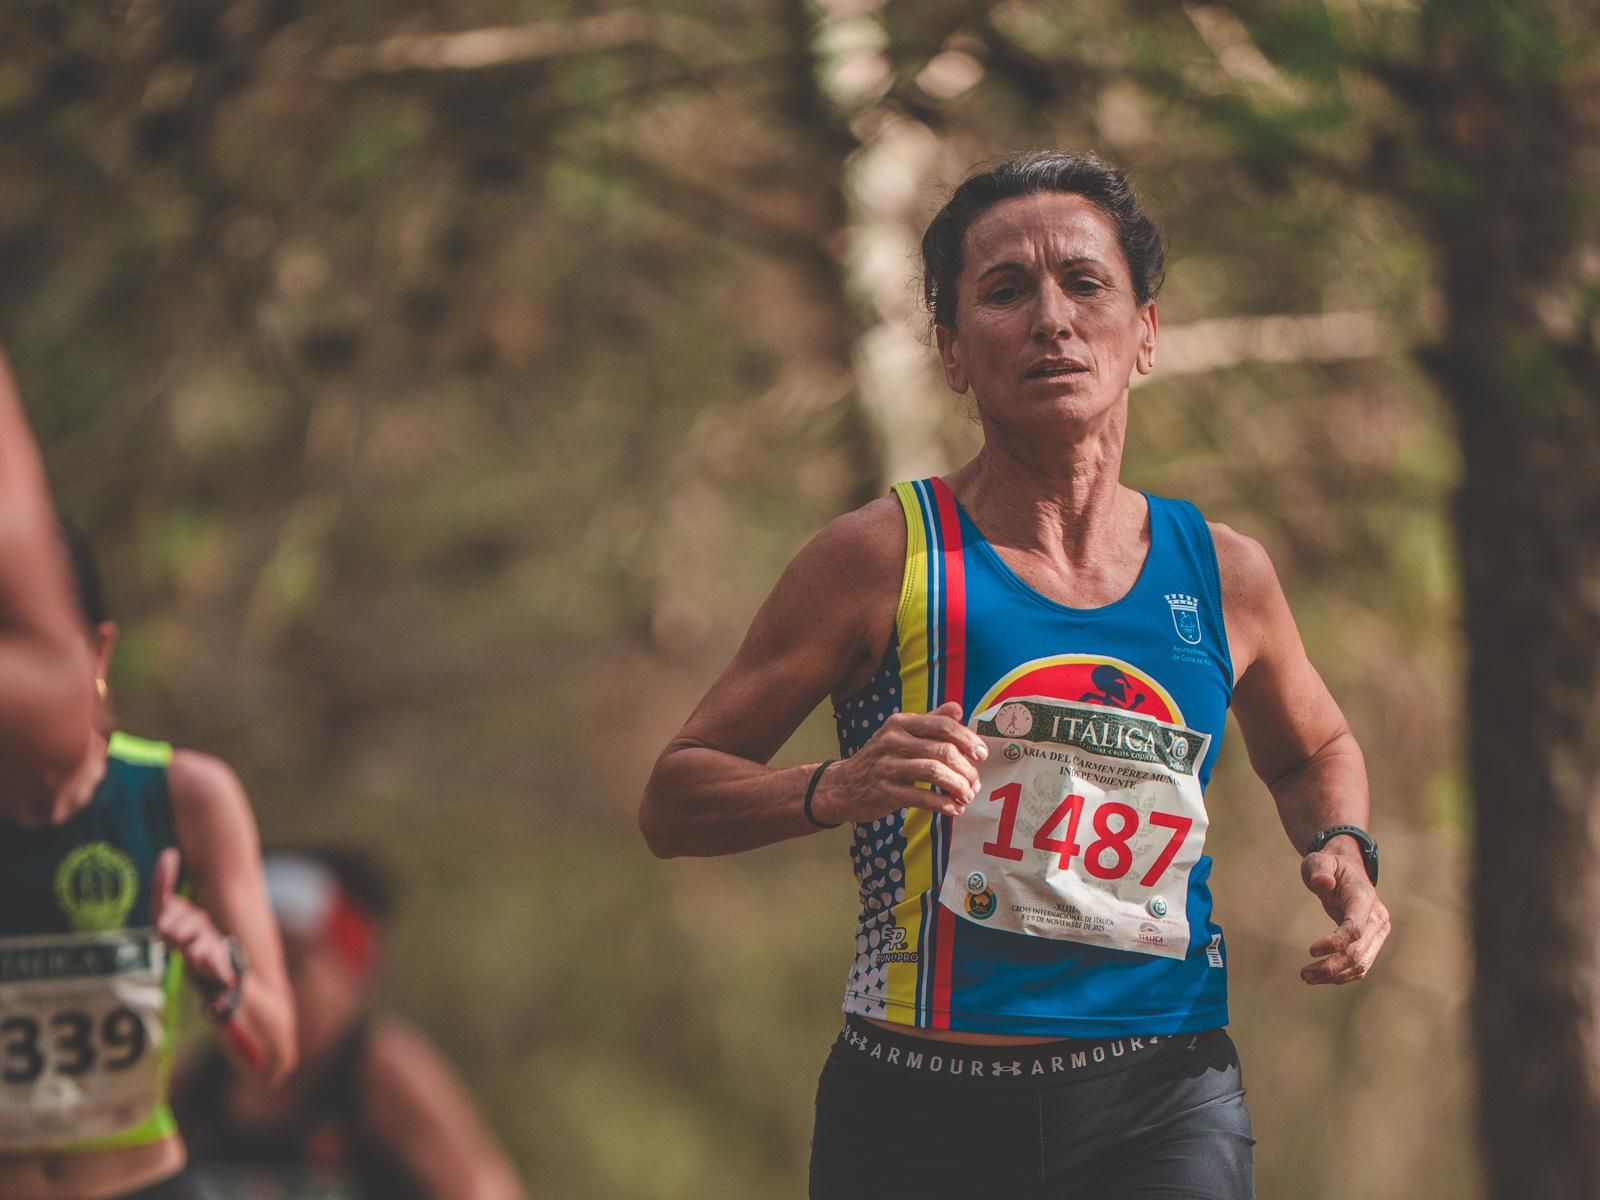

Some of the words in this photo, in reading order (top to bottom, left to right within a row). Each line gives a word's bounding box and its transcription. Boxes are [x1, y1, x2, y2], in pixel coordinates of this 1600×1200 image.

[1051, 714, 1156, 754] ITÁLICA
[1022, 747, 1046, 759] ARIA
[1049, 751, 1071, 764] DEL
[1072, 756, 1117, 774] CARMEN
[1117, 765, 1149, 780] PÉREZ
[1060, 766, 1136, 789] INDEPENDIENTE
[982, 782, 1193, 887] 1487
[1032, 908, 1083, 922] INTERNACIONAL
[1036, 915, 1044, 923] DE
[1045, 917, 1082, 929] NOVIEMBRE
[1083, 922, 1091, 930] DE
[870, 1042, 985, 1077] ARMOUR
[1031, 1037, 1144, 1076] ARMOUR
